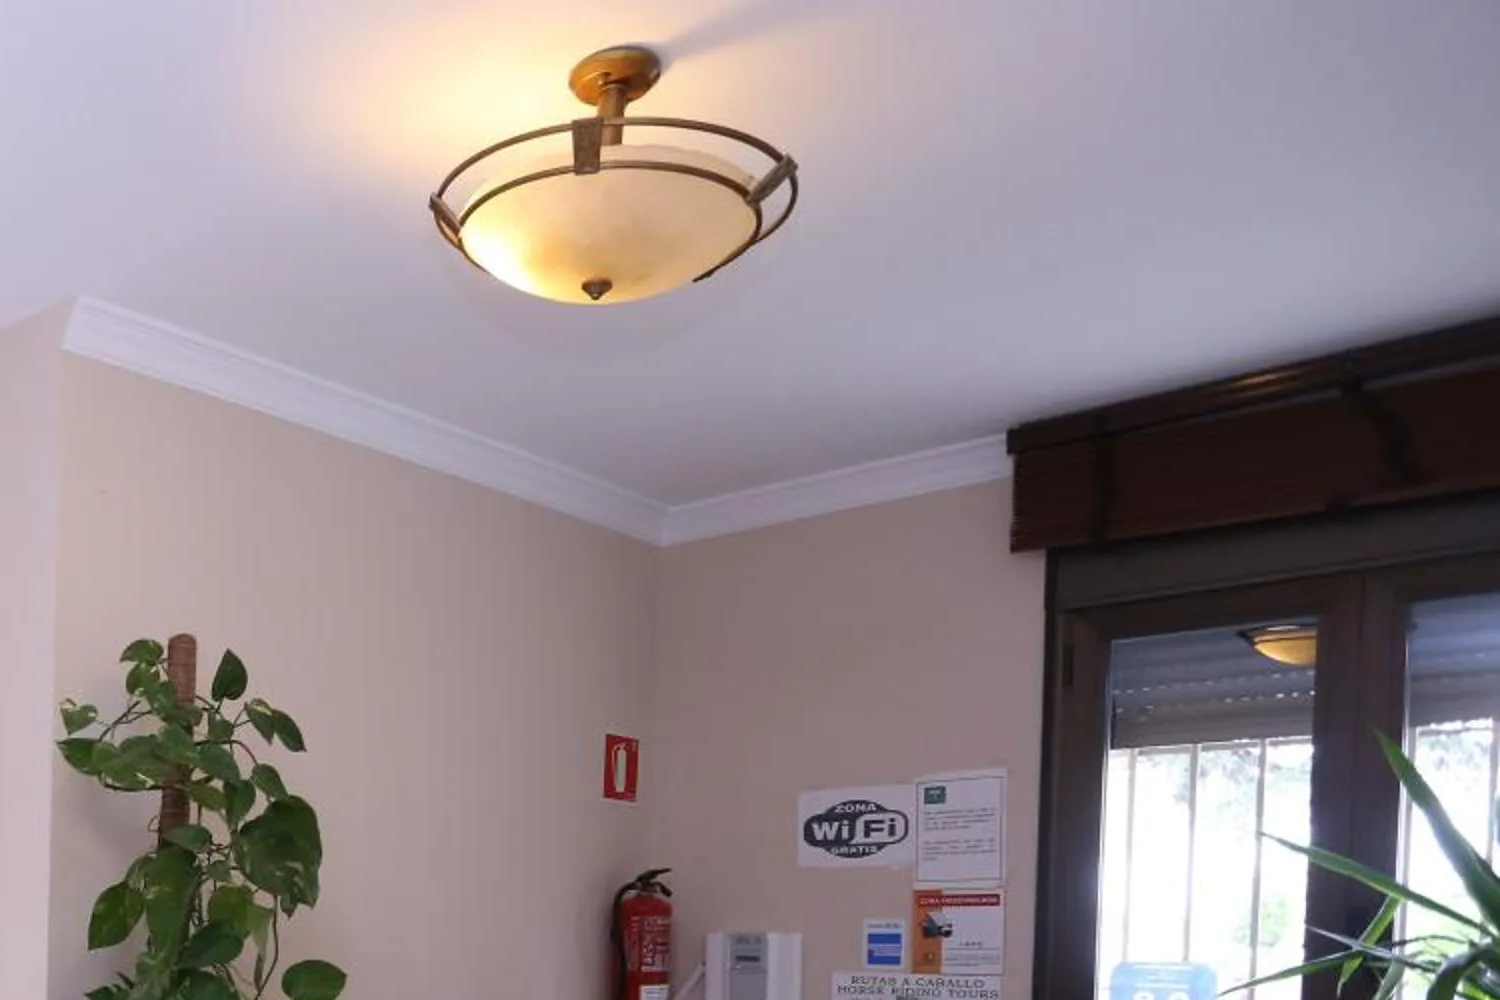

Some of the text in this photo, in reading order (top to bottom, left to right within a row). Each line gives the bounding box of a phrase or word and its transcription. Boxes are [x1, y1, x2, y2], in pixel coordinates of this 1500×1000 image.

[835, 802, 877, 813] ZONA
[812, 818, 897, 841] WiFi
[831, 846, 879, 855] GRATIS
[851, 975, 986, 989] RUTAS A CABALLO
[837, 985, 999, 999] HORSE RIDING TOURS
